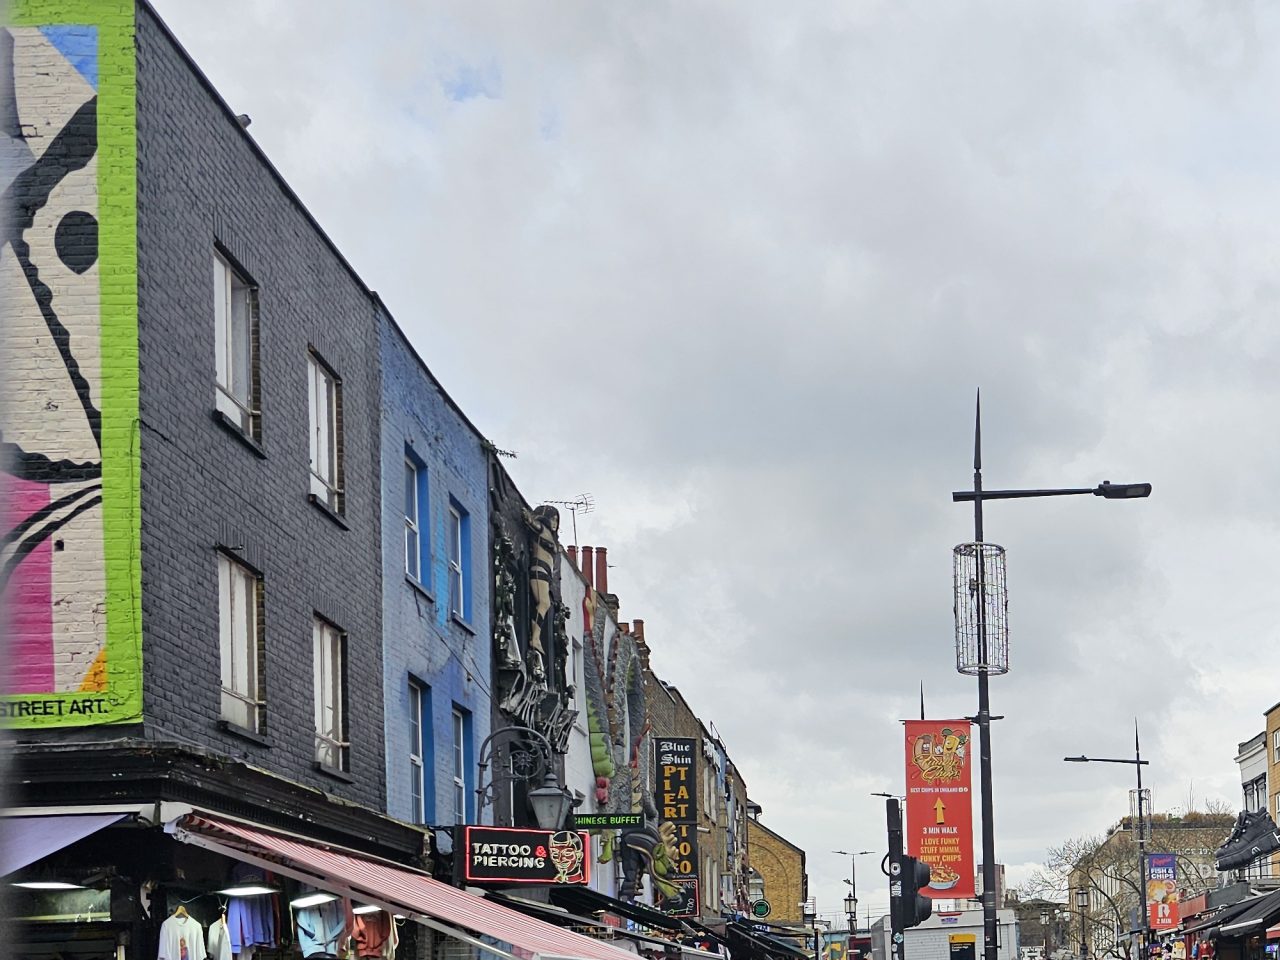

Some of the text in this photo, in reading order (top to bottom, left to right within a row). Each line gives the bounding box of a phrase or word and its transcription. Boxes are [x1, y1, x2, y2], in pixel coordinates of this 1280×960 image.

[0, 700, 66, 717] STREET
[660, 741, 690, 752] Blue
[660, 753, 692, 765] Skin
[609, 816, 641, 824] BUFFET
[677, 767, 692, 874] TATTOO
[941, 826, 958, 834] WALK
[940, 837, 960, 845] FUNKY
[472, 842, 547, 858] TATTOO &
[473, 855, 545, 869] PIERCING
